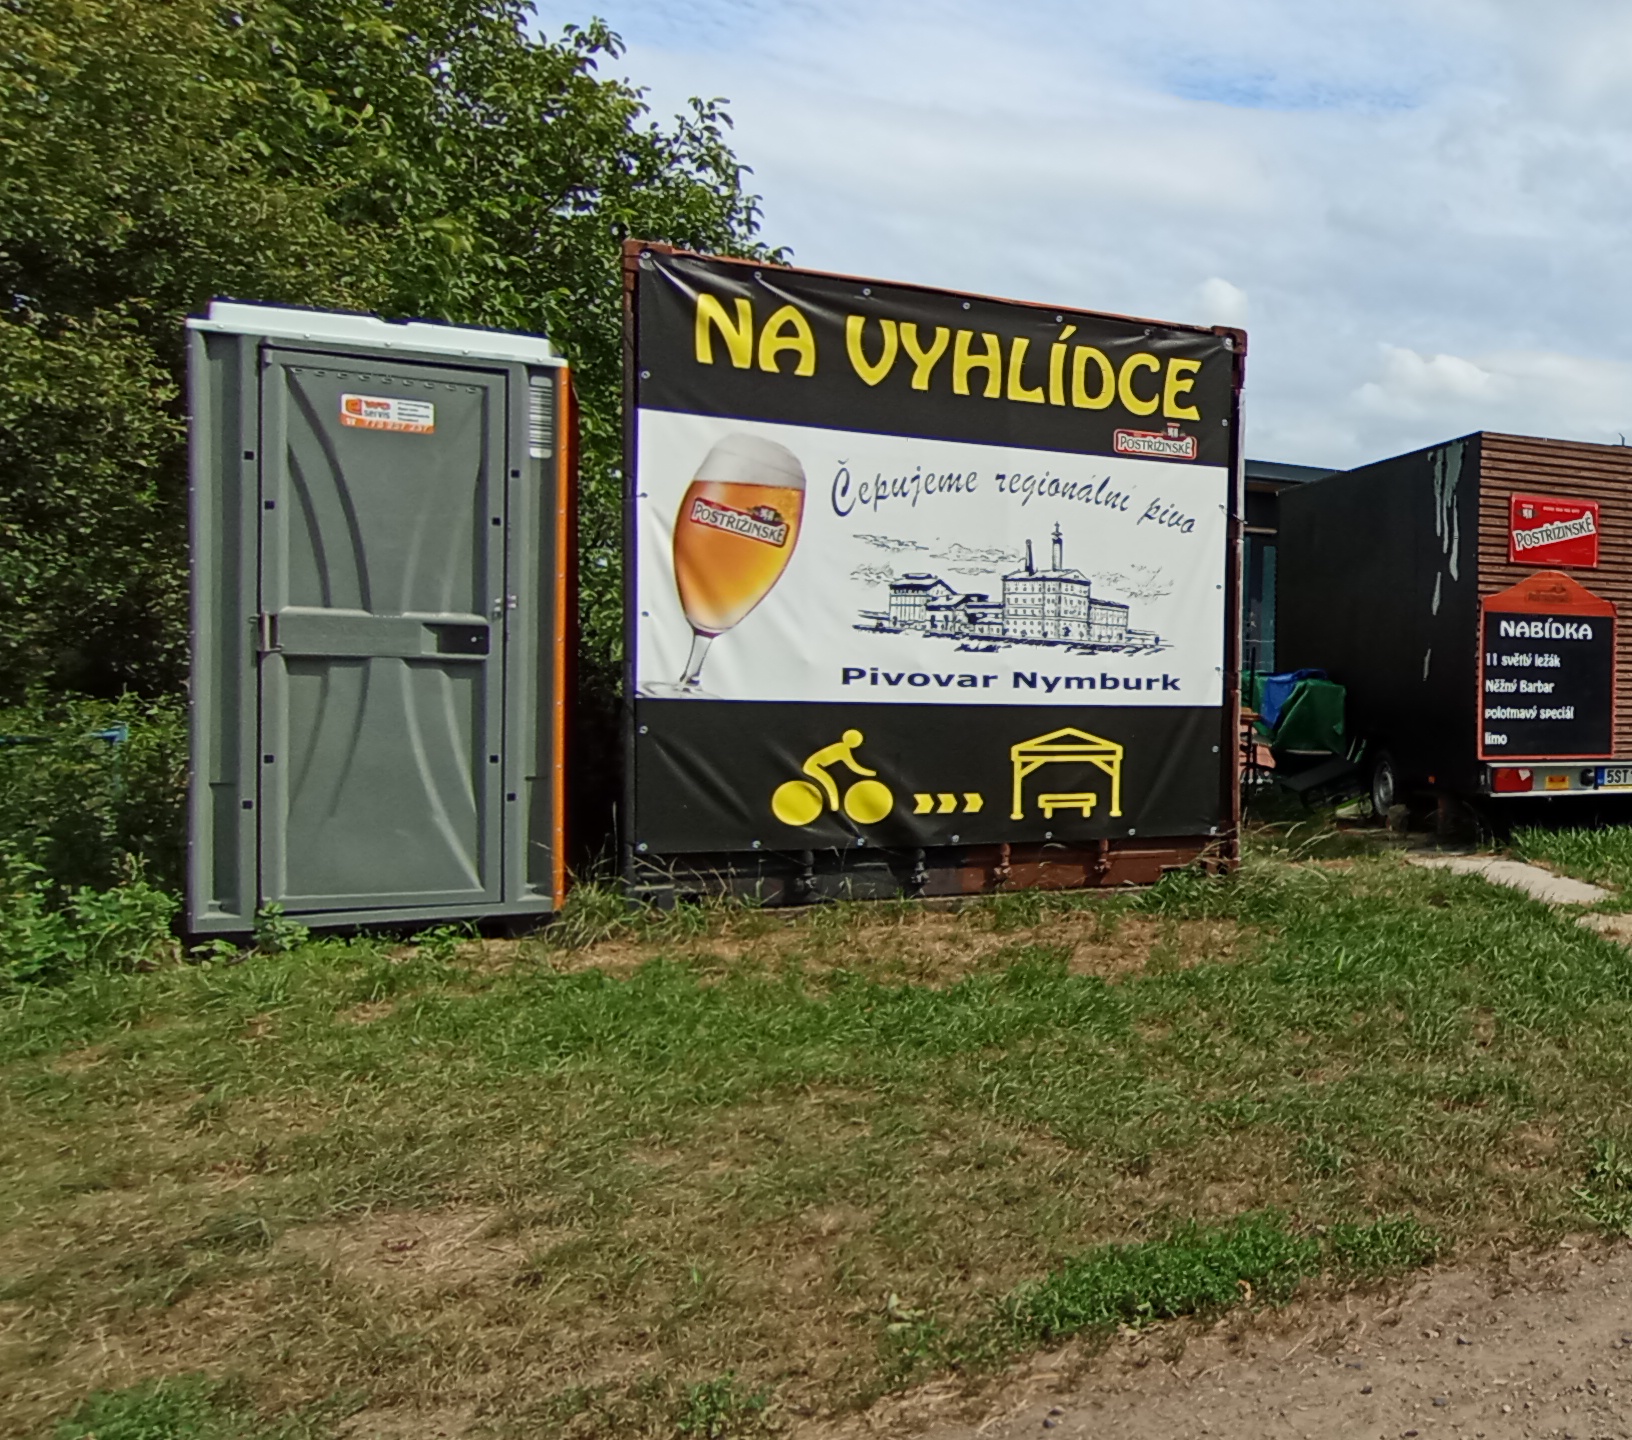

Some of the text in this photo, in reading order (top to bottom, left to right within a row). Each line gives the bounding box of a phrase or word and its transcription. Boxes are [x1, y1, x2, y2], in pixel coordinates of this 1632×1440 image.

[694, 293, 1203, 421] NA VYHLÍDCE
[364, 409, 390, 419] servis
[831, 458, 1195, 534] Čepujeme regionální pivo
[693, 502, 785, 543] POSTŘIŽINSKÉ
[1500, 617, 1593, 640] NABÍDKA
[1486, 652, 1561, 668] 11 světlý ležák
[841, 667, 1181, 693] Pivovar Nymburk
[1485, 678, 1555, 693] Něžný Barbar
[1484, 705, 1575, 719] polotmavý speciál
[1606, 769, 1628, 784] 5ST
